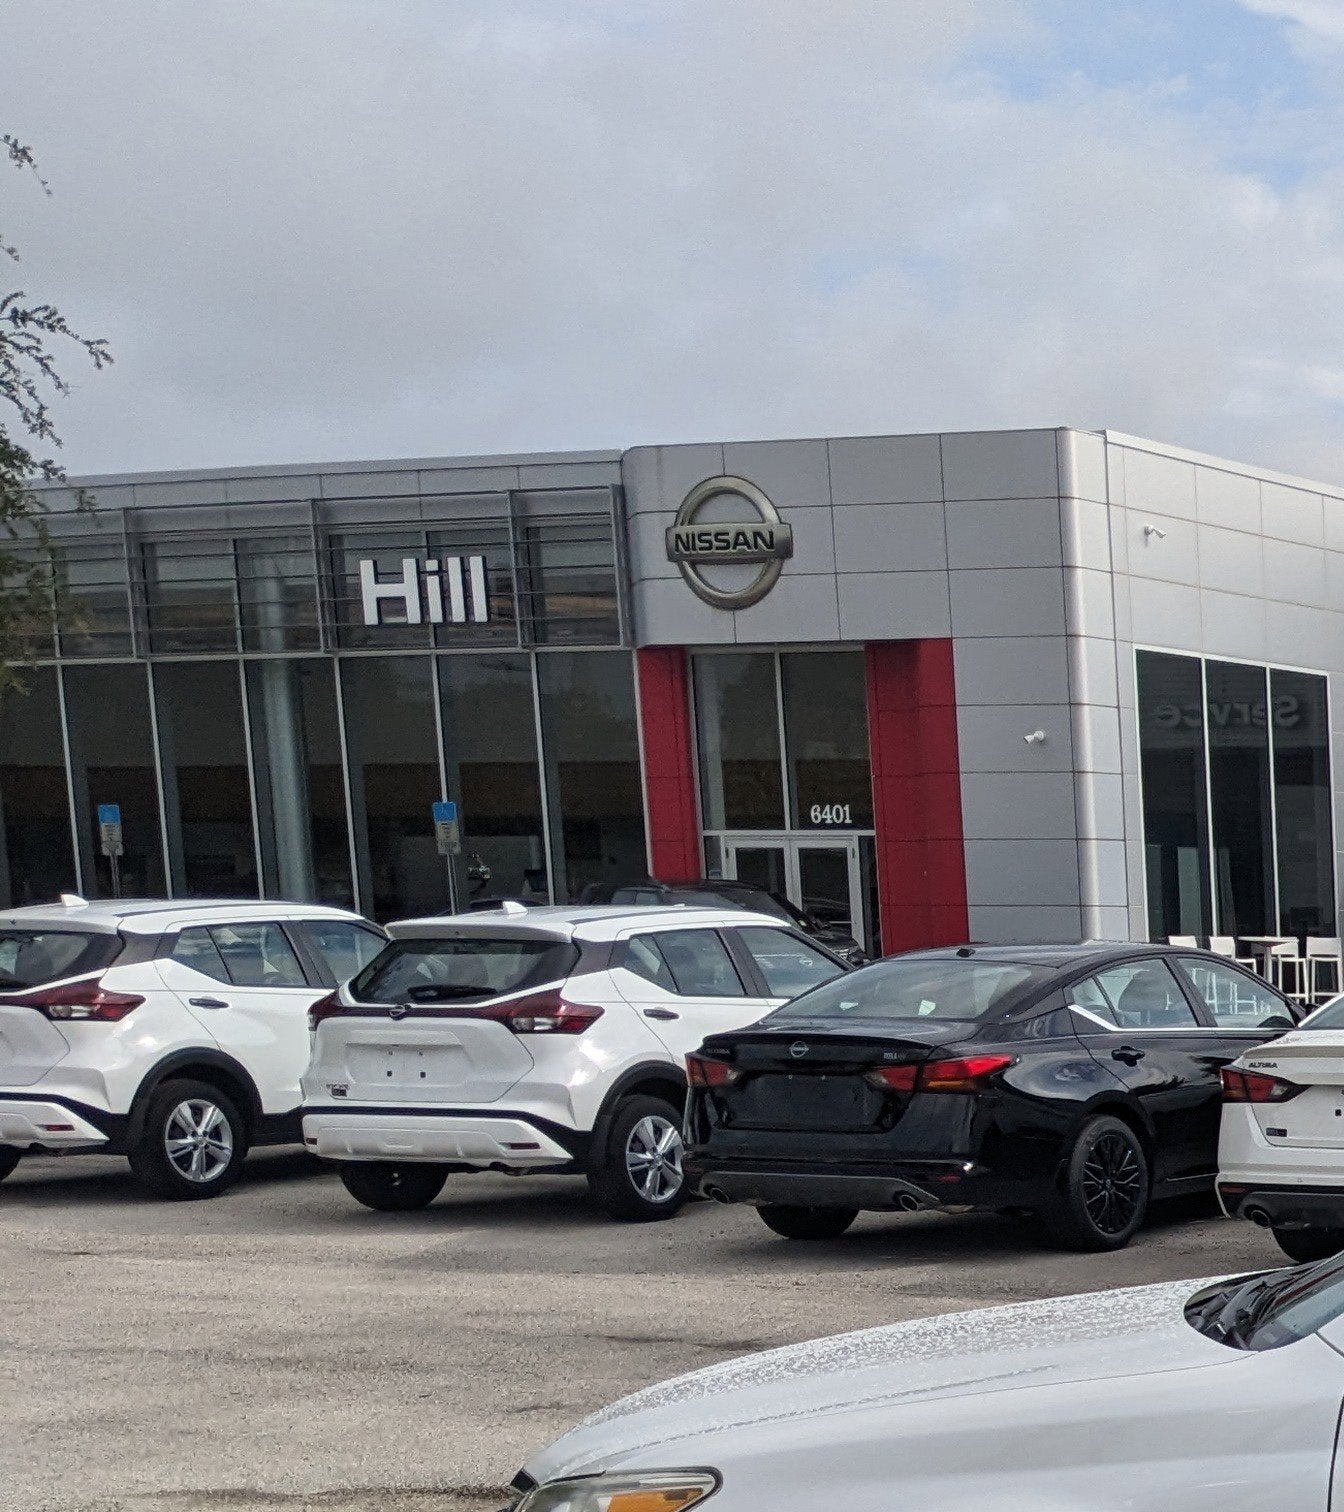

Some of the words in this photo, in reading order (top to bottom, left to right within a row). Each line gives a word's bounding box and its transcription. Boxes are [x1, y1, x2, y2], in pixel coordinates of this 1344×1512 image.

[674, 530, 776, 553] NISSAN
[360, 556, 488, 626] Hill
[810, 804, 853, 824] 6401
